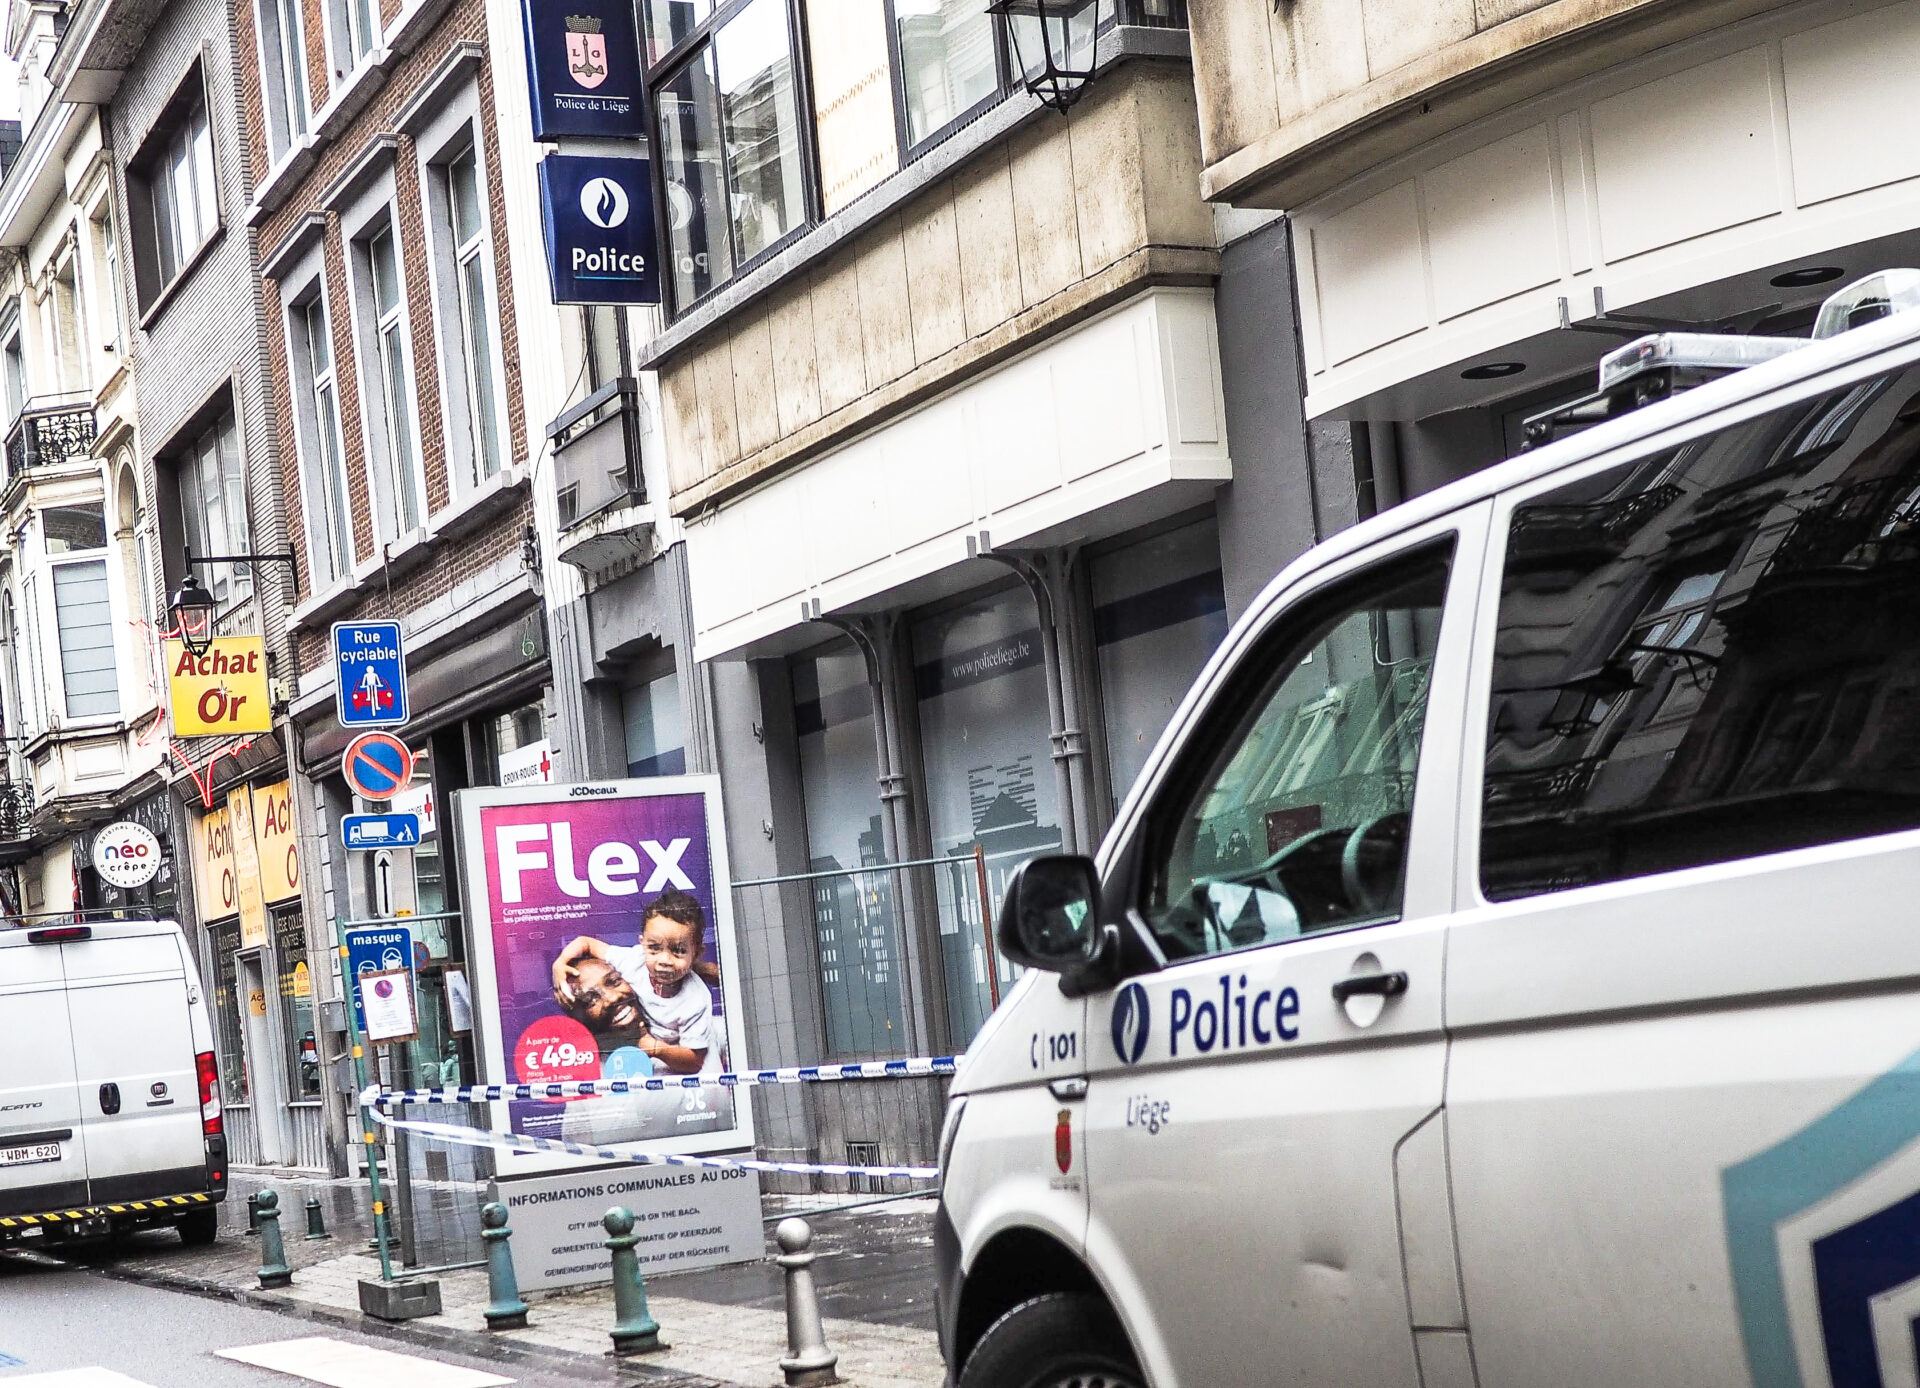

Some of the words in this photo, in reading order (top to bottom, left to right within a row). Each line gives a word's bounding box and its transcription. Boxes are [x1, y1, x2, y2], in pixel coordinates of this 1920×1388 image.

[572, 48, 581, 57] L
[555, 98, 586, 110] Police
[588, 99, 599, 110] de
[602, 100, 630, 114] Liège
[572, 247, 645, 272] Police
[354, 630, 380, 644] Rue
[174, 649, 259, 677] Achat
[340, 647, 397, 665] cyclable
[952, 640, 1030, 678] www.policeliege.be
[197, 687, 247, 724] Or
[503, 763, 538, 785] CROIX-ROUGE
[569, 786, 618, 797] JCDecaux
[104, 838, 149, 860] néo
[109, 861, 147, 873] crêpe
[495, 821, 697, 904] Flex
[502, 907, 539, 917] Composez
[539, 905, 556, 913] votre
[556, 903, 571, 912] pack
[572, 902, 592, 910] selon
[554, 912, 563, 920] de
[563, 911, 588, 919] chacun
[352, 933, 402, 946] masque
[1169, 973, 1300, 1057] Police
[525, 1051, 540, 1070] €
[542, 1043, 595, 1068] 49,99
[1049, 1031, 1077, 1062] 101
[676, 1110, 717, 1125] proximus
[1126, 1094, 1170, 1136] Liège
[508, 1184, 604, 1208] INFORMATIONS
[606, 1173, 696, 1195] COMMUNALES
[700, 1169, 719, 1184] AU
[721, 1166, 747, 1181] DOS
[567, 1222, 587, 1232] CITY
[661, 1210, 677, 1219] THE
[667, 1230, 679, 1240] OP
[680, 1226, 723, 1239] KEERZIJDE
[651, 1253, 667, 1263] AUF
[668, 1251, 685, 1261] DER
[686, 1244, 730, 1258] RÜCKSEITE
